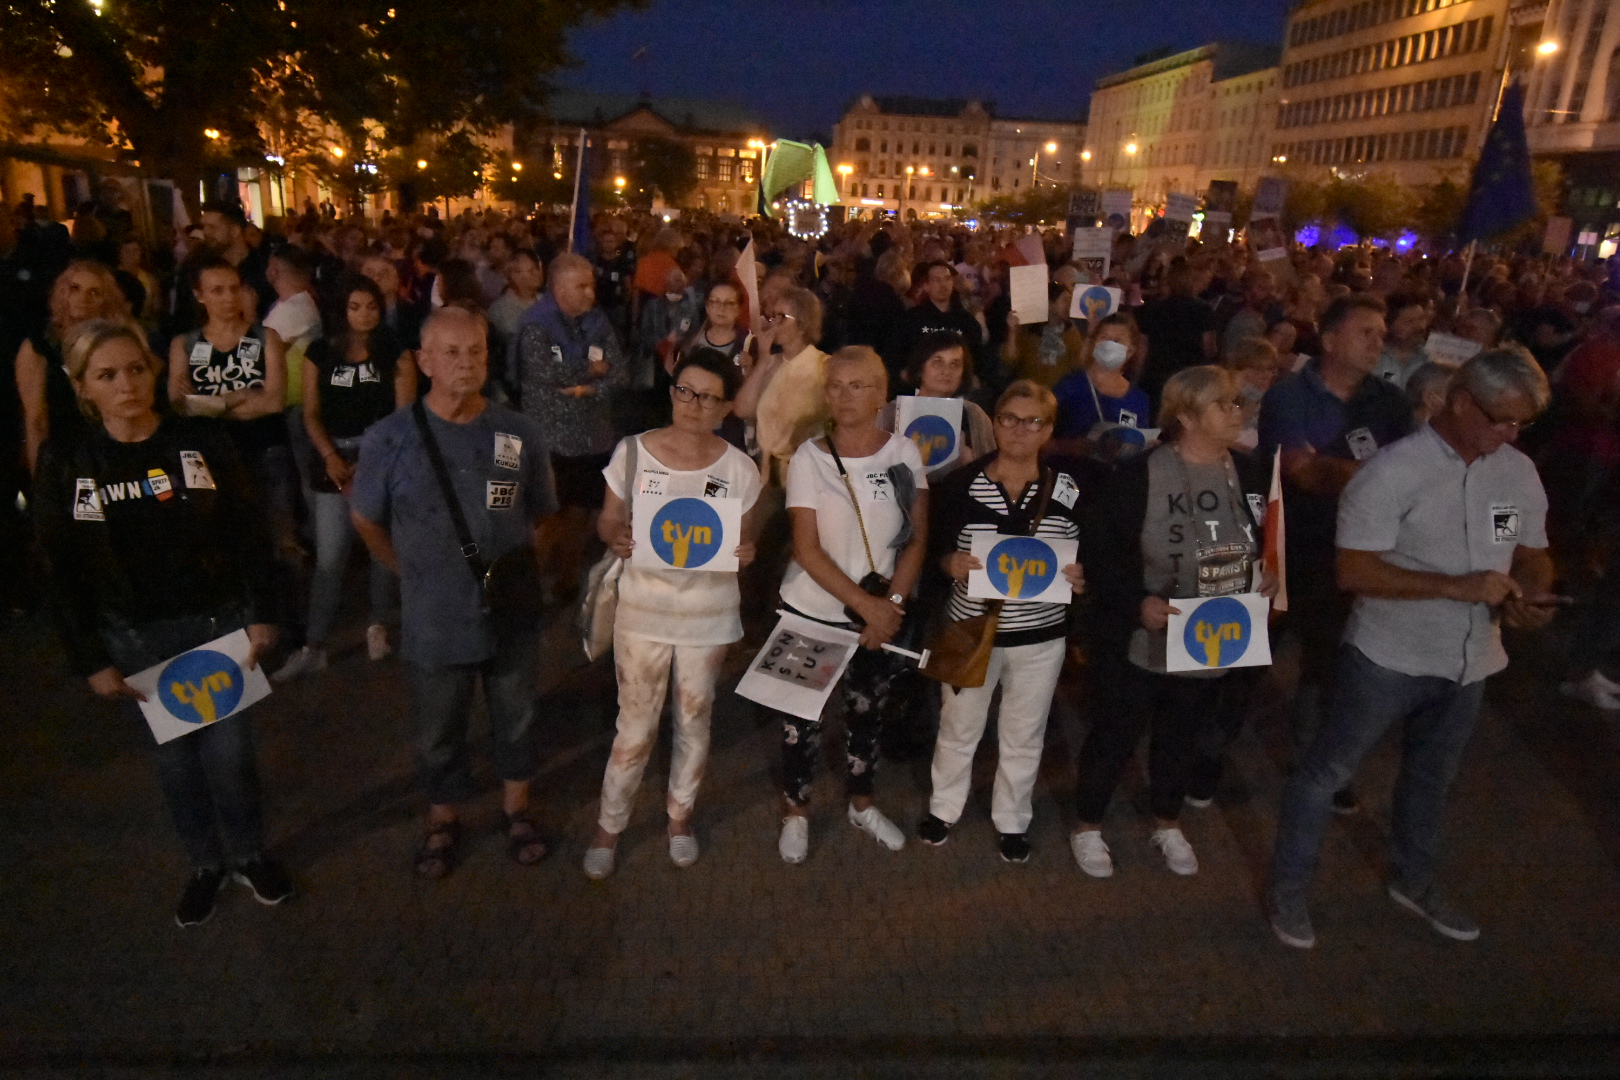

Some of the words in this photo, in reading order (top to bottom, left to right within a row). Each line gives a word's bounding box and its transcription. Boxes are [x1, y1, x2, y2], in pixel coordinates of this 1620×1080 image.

[661, 520, 712, 546] tvn
[997, 553, 1047, 577] tvn
[1195, 620, 1242, 643] tvn
[171, 671, 233, 704] tvn
